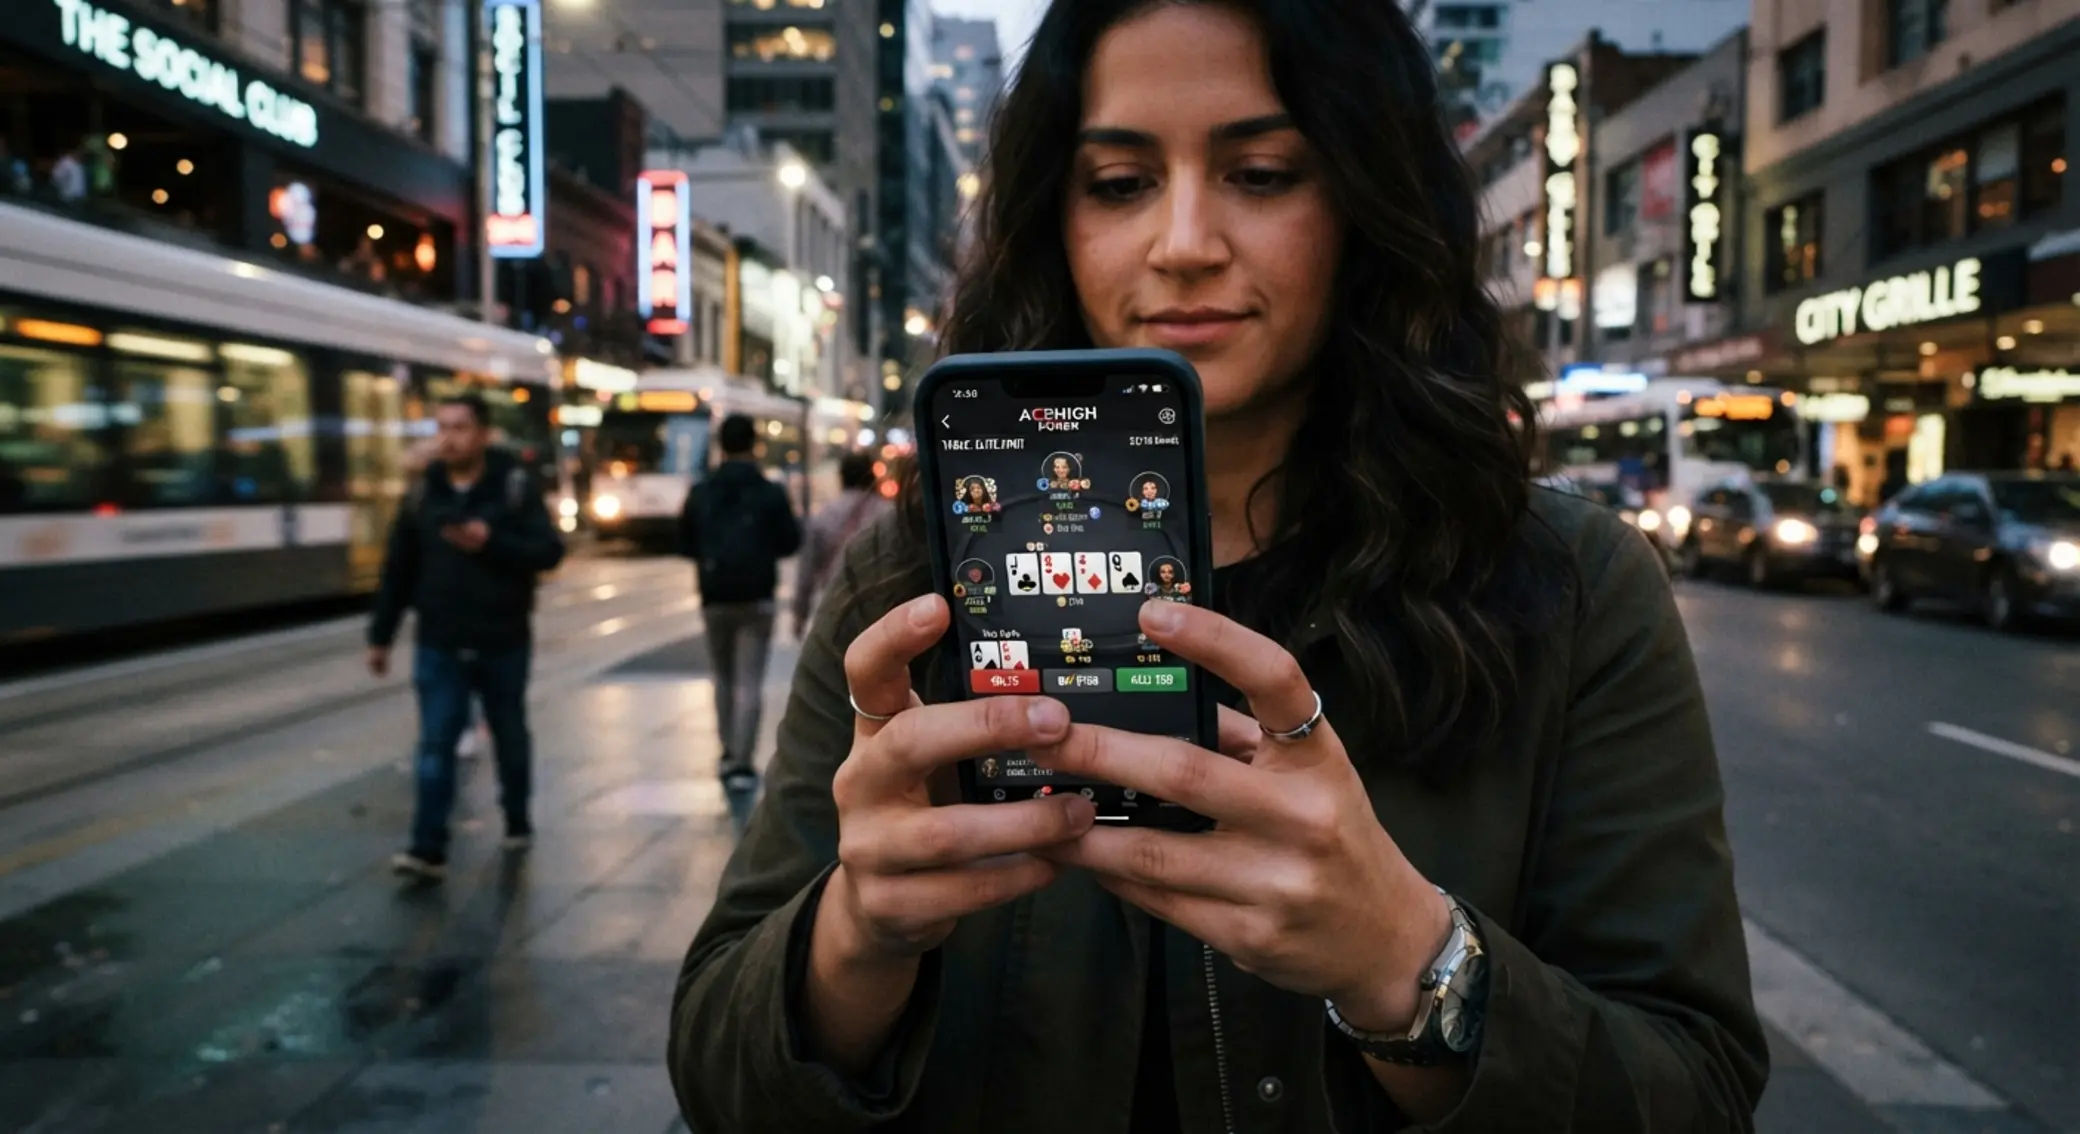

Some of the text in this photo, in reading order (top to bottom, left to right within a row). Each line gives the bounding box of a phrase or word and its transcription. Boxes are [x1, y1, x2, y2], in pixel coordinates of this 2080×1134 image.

[53, 0, 318, 148] THE SOCIAL CLUB
[1796, 257, 1981, 344] CITY GRILLE
[1019, 406, 1097, 422] ACEHIGH
